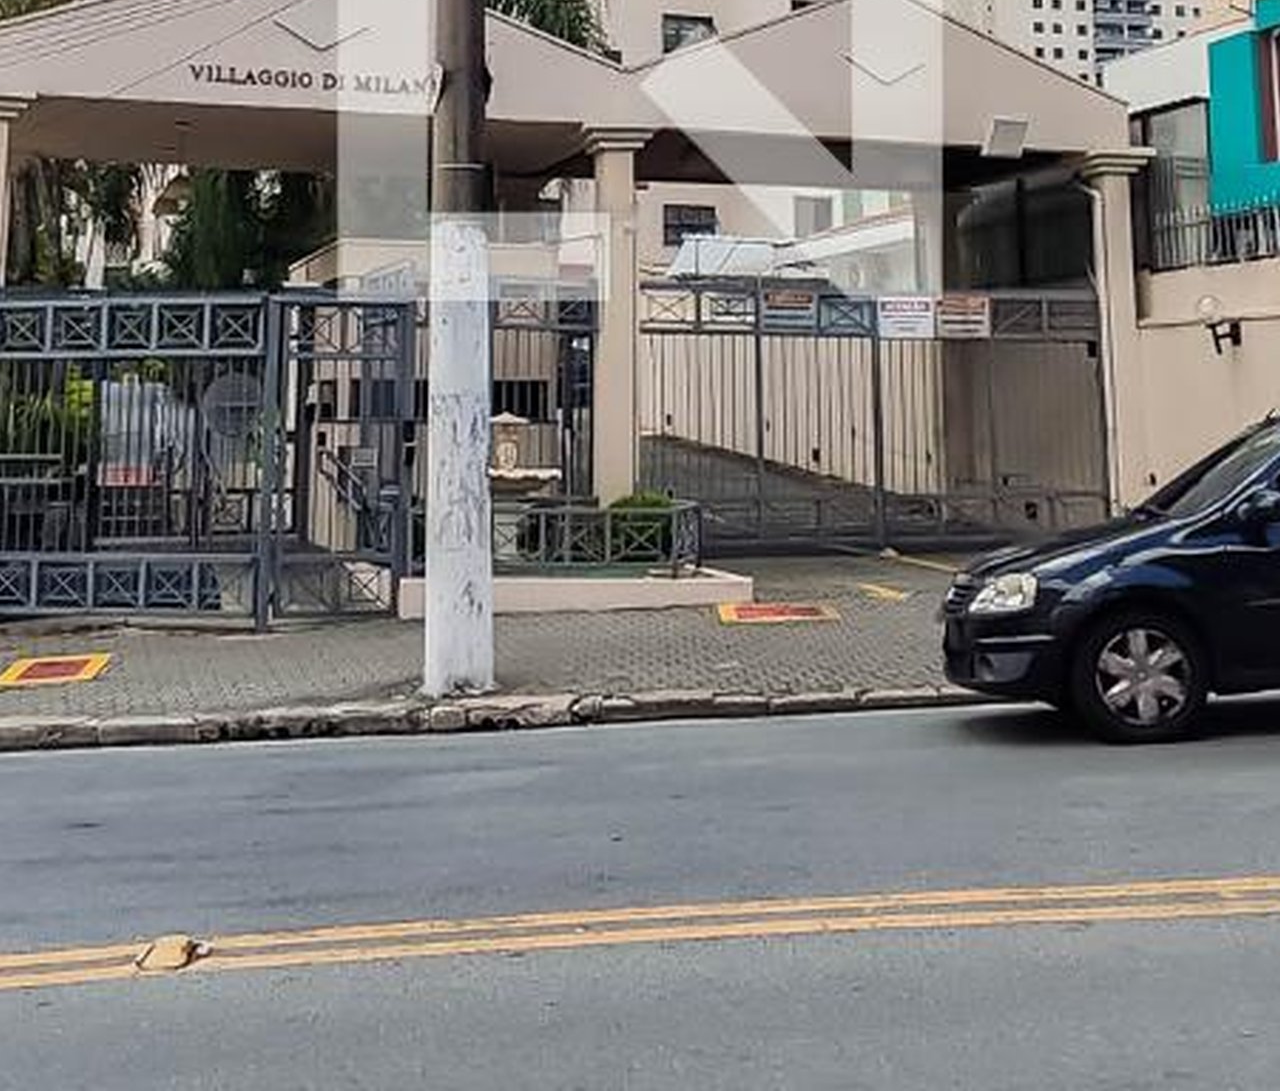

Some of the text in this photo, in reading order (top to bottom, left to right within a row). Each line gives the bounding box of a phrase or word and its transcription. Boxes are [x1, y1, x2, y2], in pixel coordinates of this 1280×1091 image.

[188, 64, 438, 95] VILLAGGIO DI MILAN
